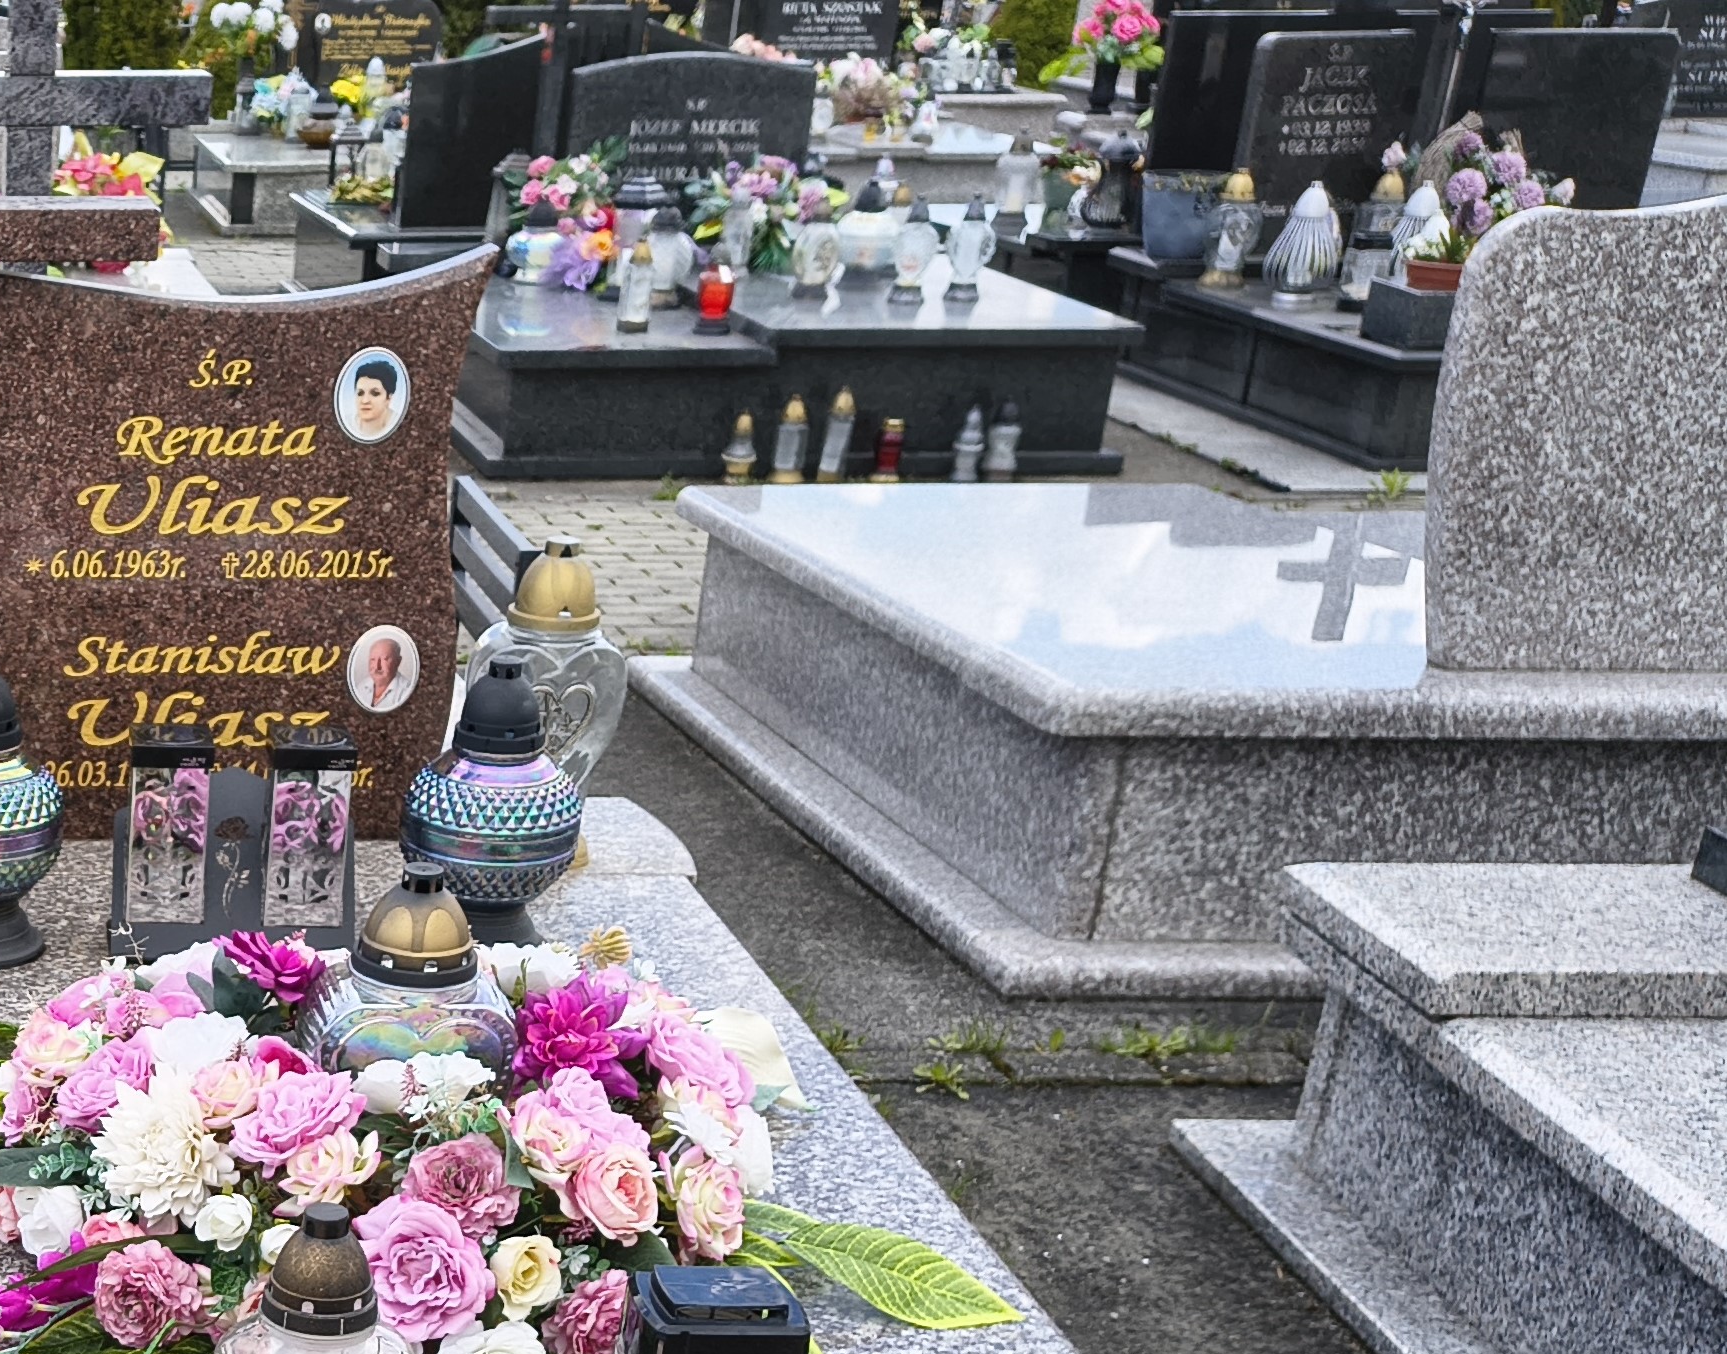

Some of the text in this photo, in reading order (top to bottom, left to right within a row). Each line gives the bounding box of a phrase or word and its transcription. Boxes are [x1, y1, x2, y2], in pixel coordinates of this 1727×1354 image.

[188, 348, 254, 388] Ś.P.
[116, 415, 317, 465] Renata
[77, 475, 351, 536] Uliasz
[63, 630, 341, 677] Stanisław
[67, 691, 330, 747] Ulias
